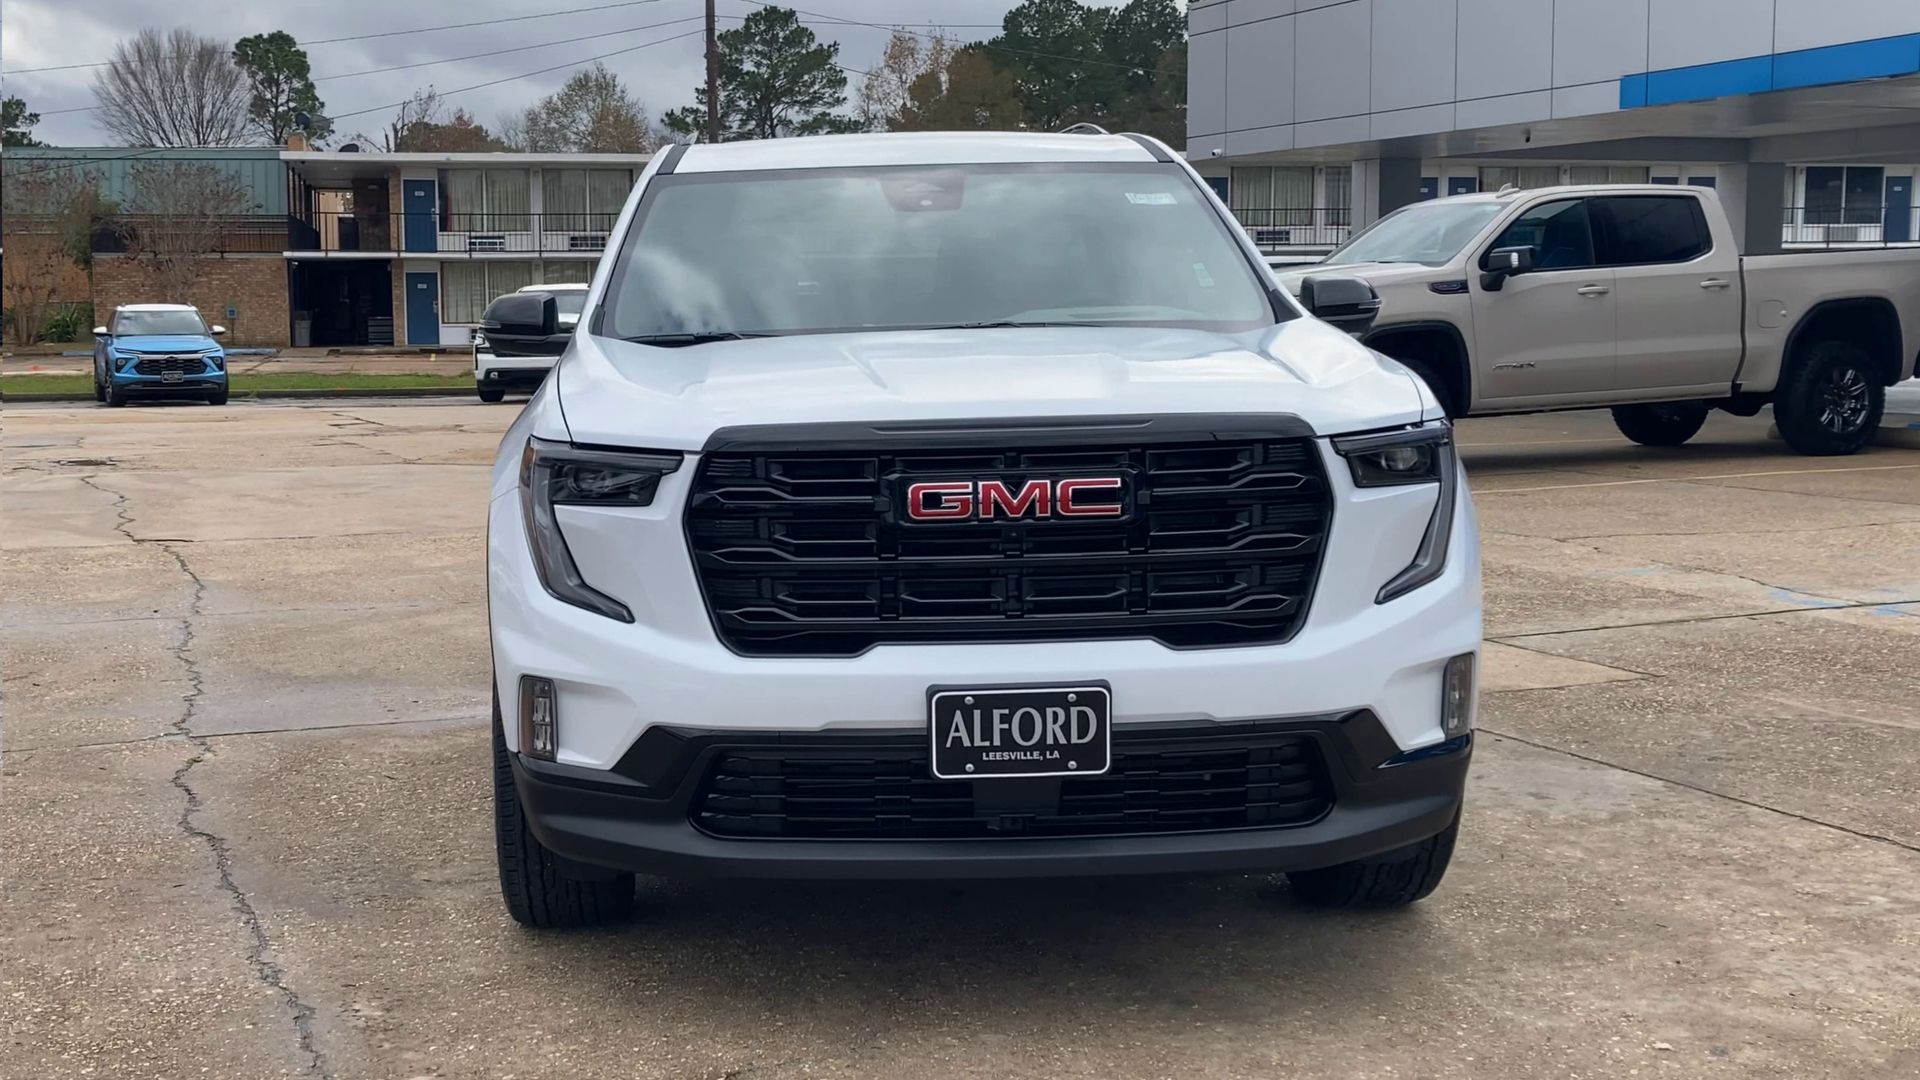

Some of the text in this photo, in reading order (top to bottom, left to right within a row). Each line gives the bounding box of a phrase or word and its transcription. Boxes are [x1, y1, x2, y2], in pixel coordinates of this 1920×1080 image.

[908, 477, 1122, 520] GMC
[945, 706, 1098, 748] ALFORD
[982, 750, 1060, 761] LEESVILLE, LA
